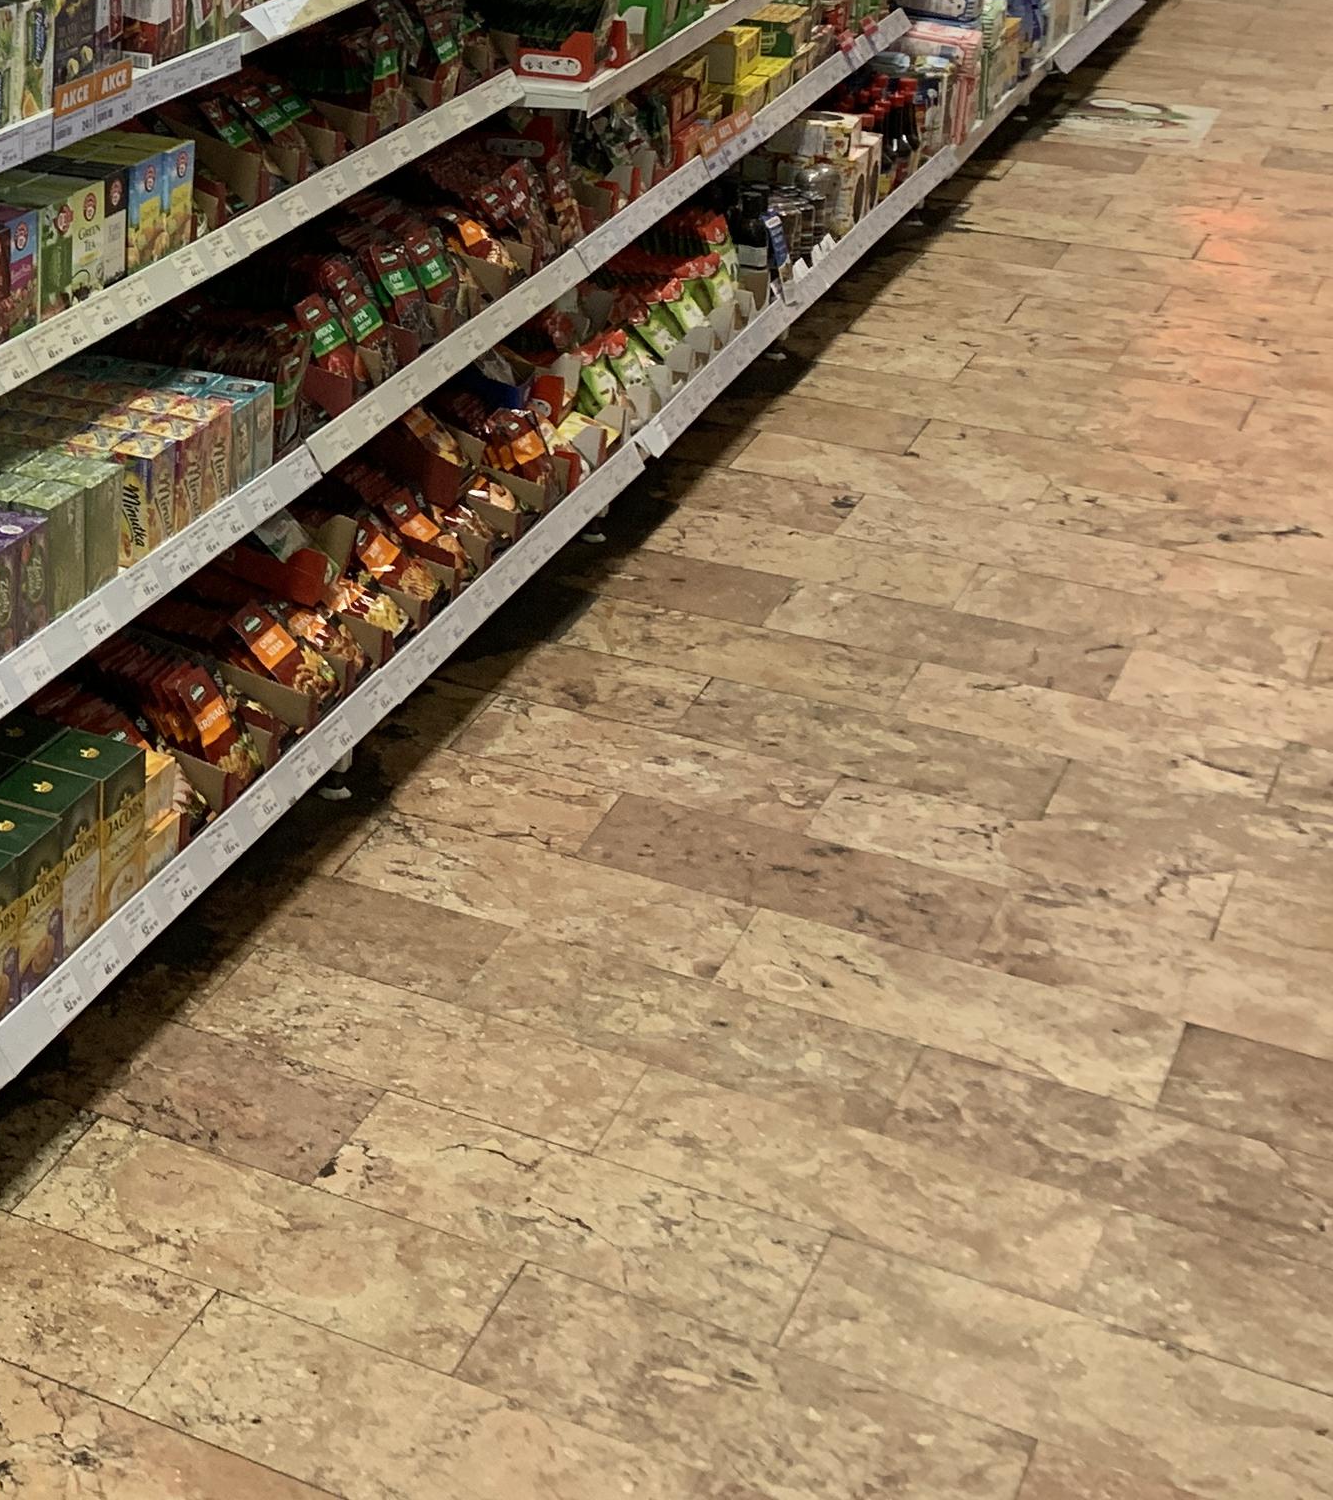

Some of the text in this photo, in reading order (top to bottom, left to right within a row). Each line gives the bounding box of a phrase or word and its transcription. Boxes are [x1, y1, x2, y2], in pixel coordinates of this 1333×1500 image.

[101, 70, 127, 93] AKCE
[61, 84, 90, 108] AKCE
[78, 224, 102, 244] GREEN
[82, 241, 96, 254] TEA
